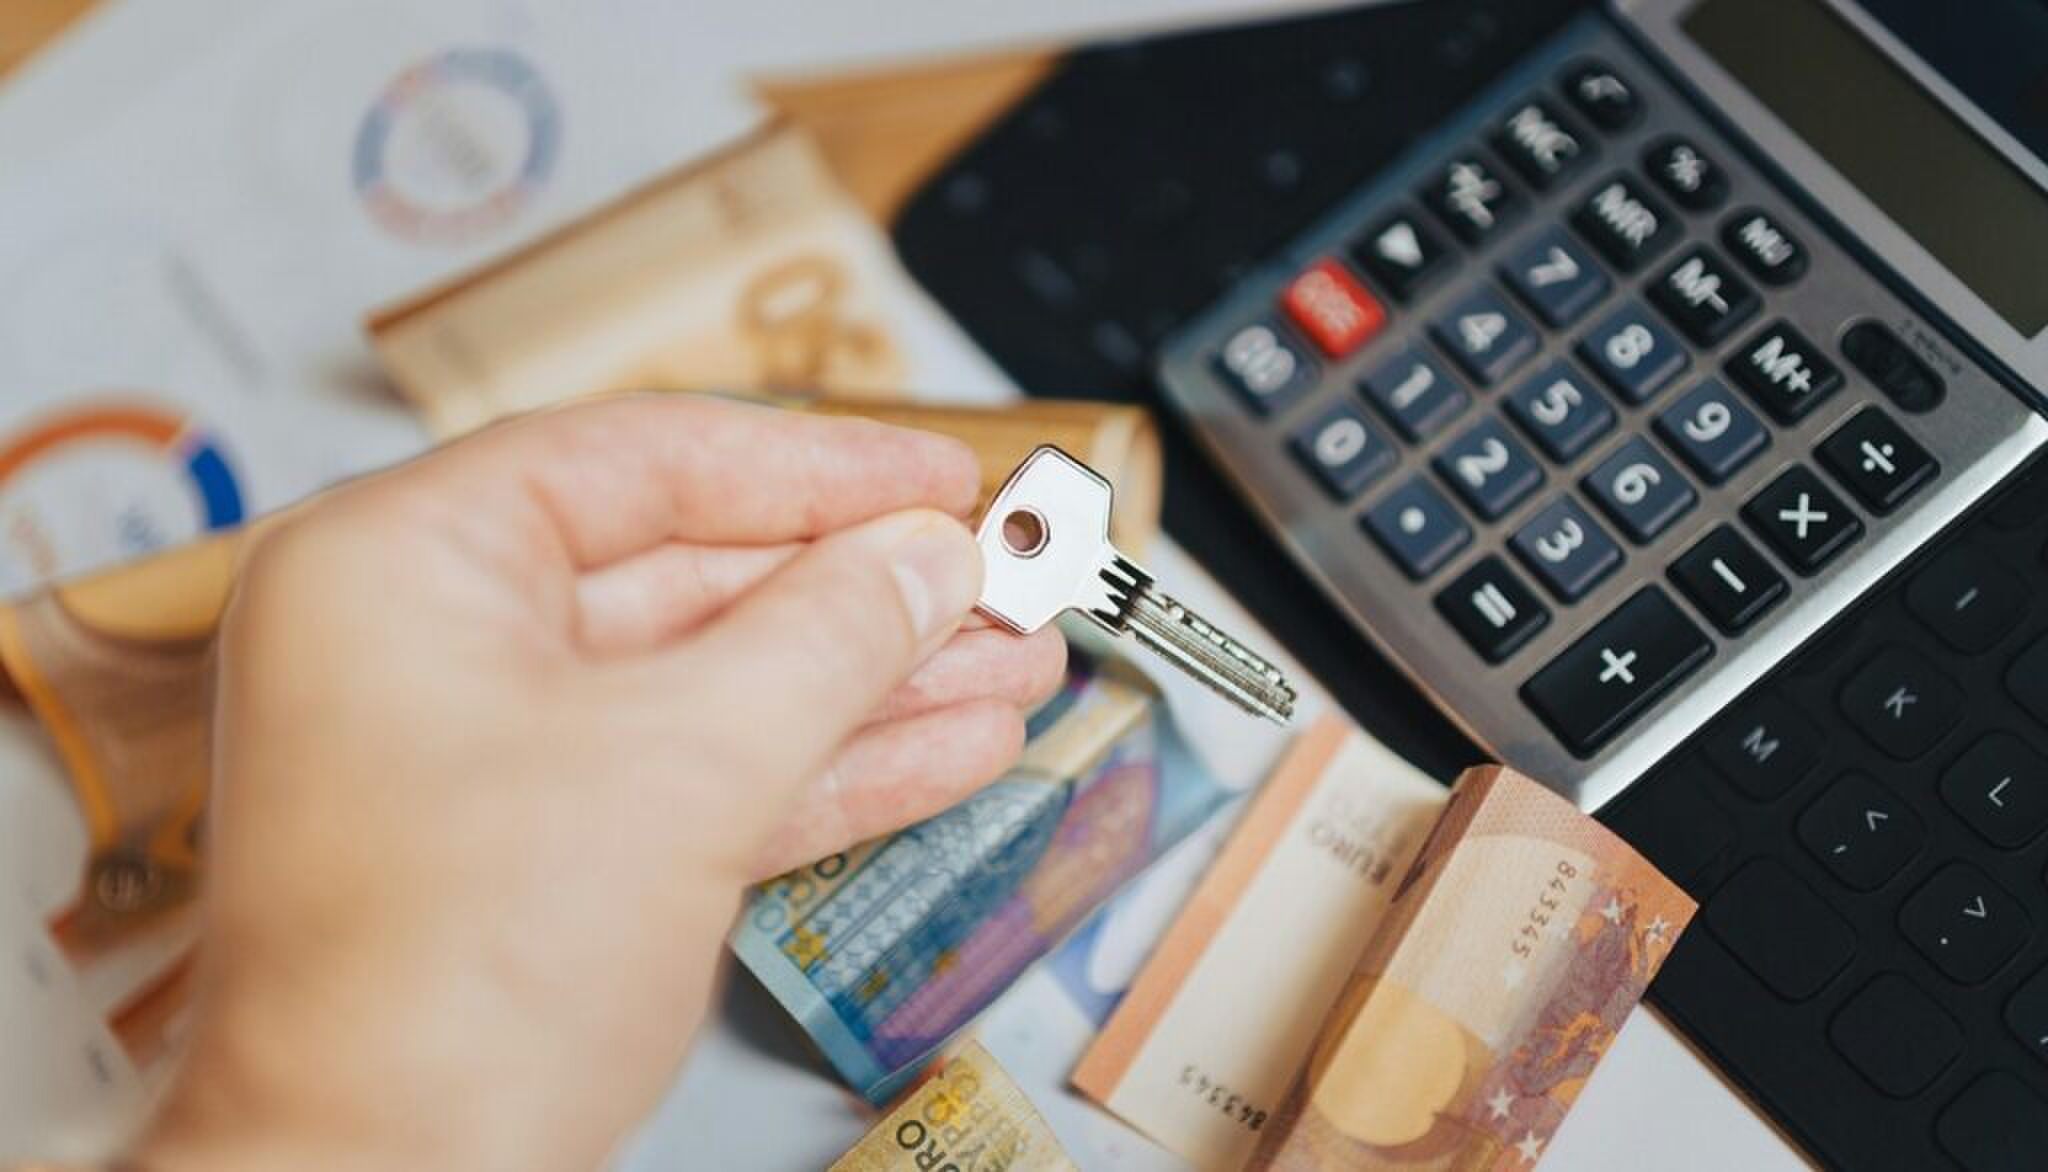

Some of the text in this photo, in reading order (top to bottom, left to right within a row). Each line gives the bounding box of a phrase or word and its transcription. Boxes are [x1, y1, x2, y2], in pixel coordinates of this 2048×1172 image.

[1508, 106, 1579, 172] MC
[1594, 184, 1657, 246] MR
[1528, 247, 1579, 287] 7
[1458, 313, 1506, 353] 4
[1606, 324, 1655, 369] 8
[1391, 364, 1434, 409] 1
[1753, 336, 1811, 392] M+
[1531, 379, 1582, 425] 5
[1684, 401, 1731, 442] 9
[1315, 418, 1367, 466] 0
[1458, 438, 1508, 487] 2
[1612, 463, 1660, 503] 6
[1536, 519, 1585, 562] 3
[1885, 687, 1917, 718] K
[1742, 726, 1780, 762] M
[1988, 777, 2011, 807] L
[1511, 860, 1577, 958] 843345
